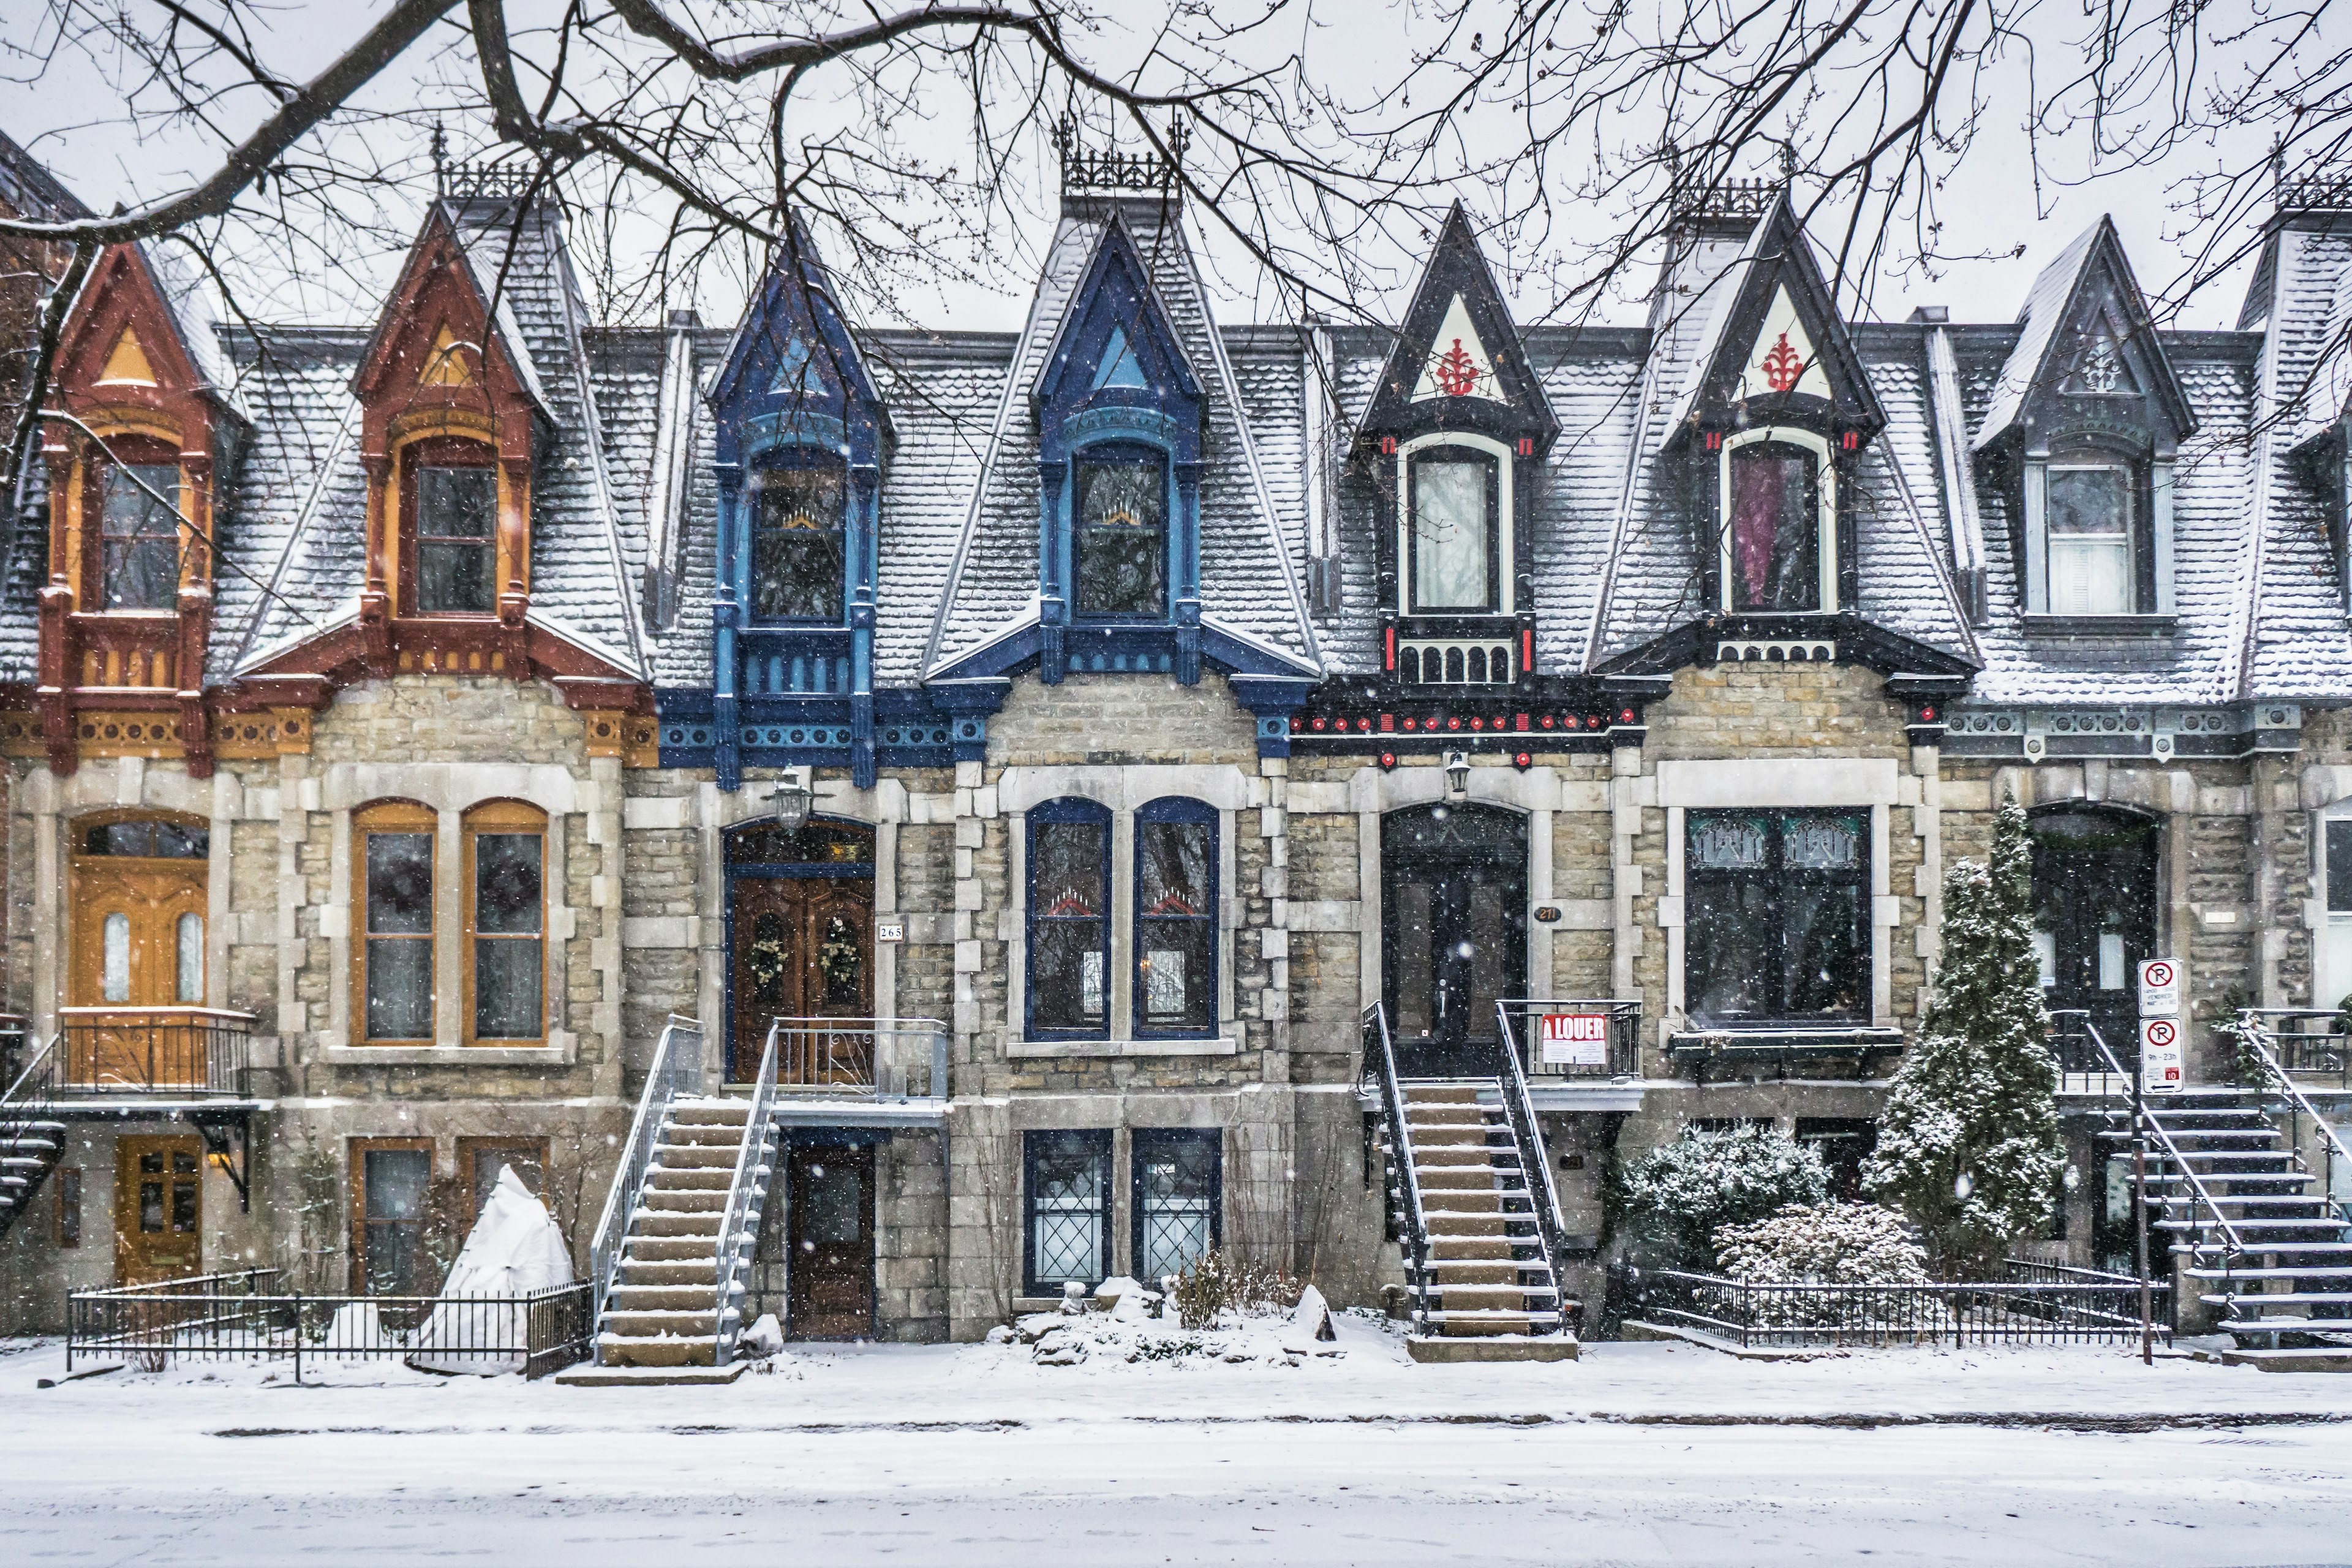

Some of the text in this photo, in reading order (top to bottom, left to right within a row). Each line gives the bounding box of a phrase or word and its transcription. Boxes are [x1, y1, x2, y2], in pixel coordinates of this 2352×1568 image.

[1539, 908, 1556, 920] 271
[881, 928, 901, 937] 265
[1543, 1017, 1605, 1039] À LOUER
